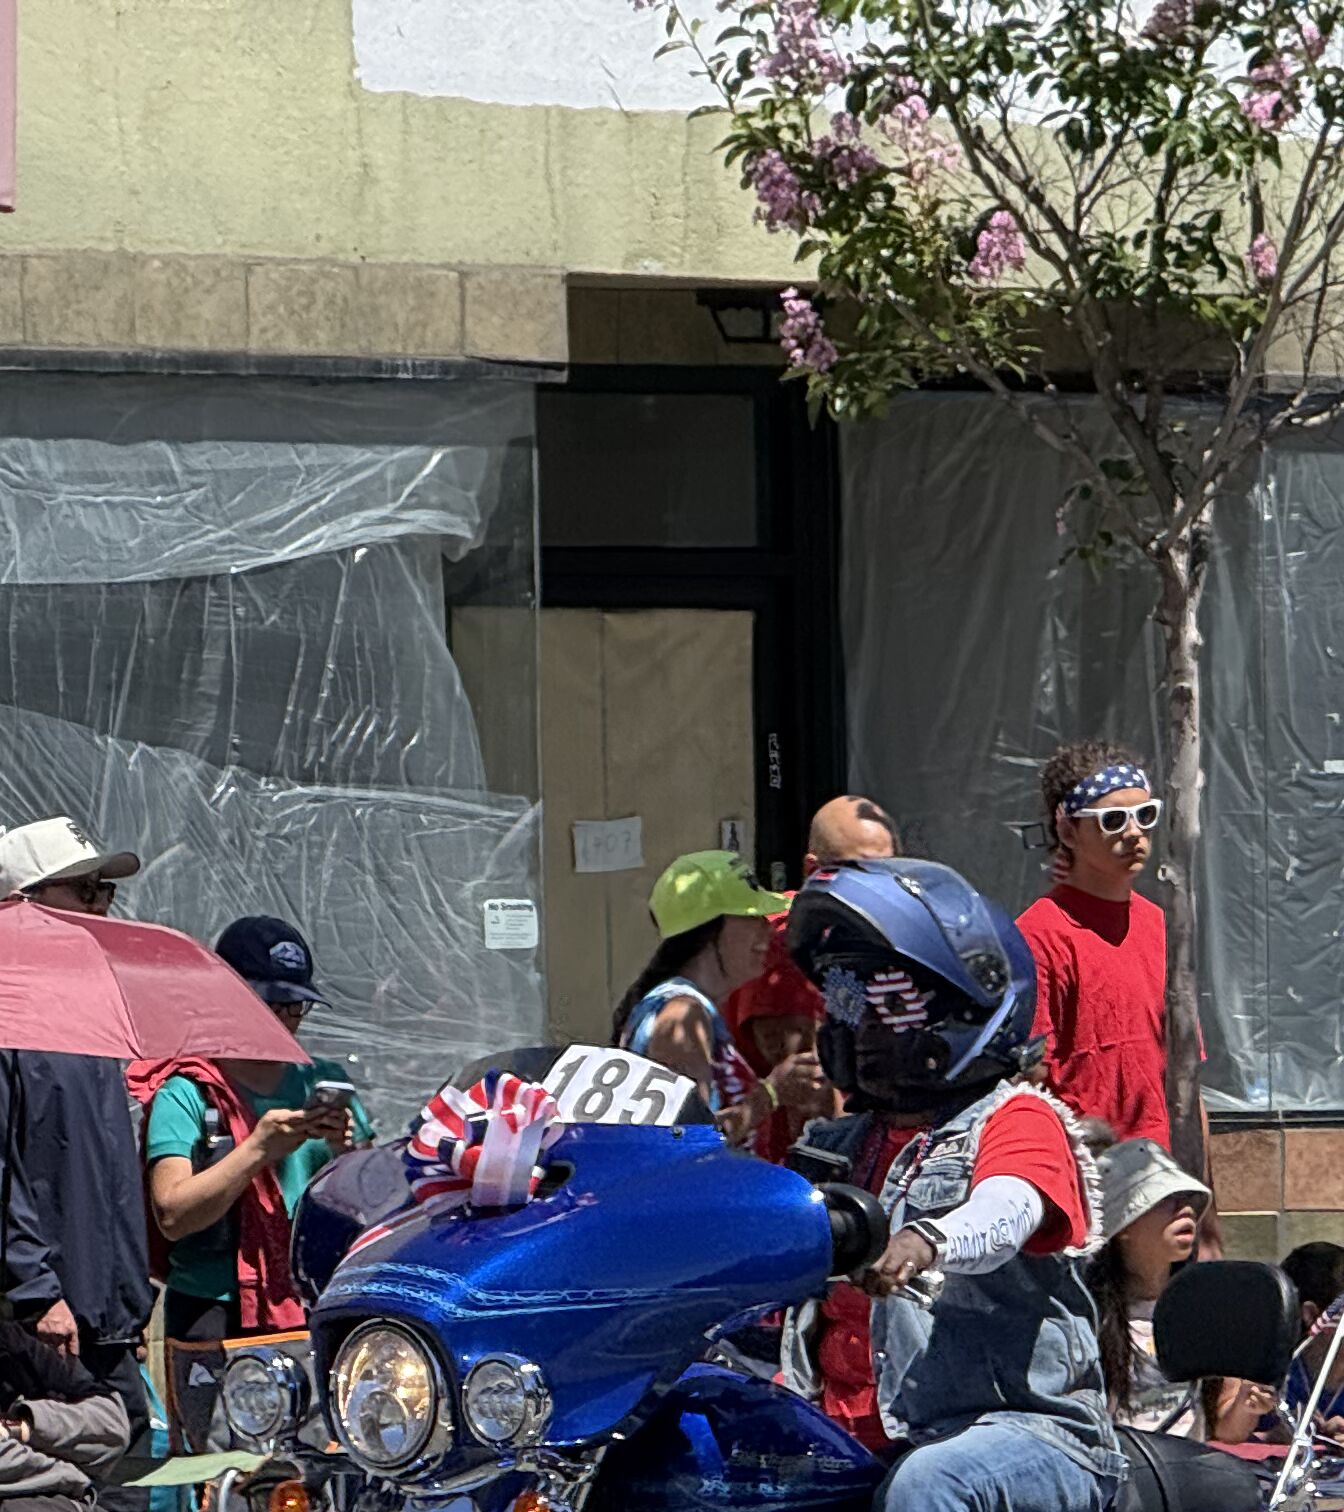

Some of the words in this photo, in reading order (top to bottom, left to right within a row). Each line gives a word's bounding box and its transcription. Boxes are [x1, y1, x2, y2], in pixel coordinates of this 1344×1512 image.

[488, 902, 499, 912] No
[501, 902, 534, 913] Smoking
[553, 1055, 679, 1126] 185
